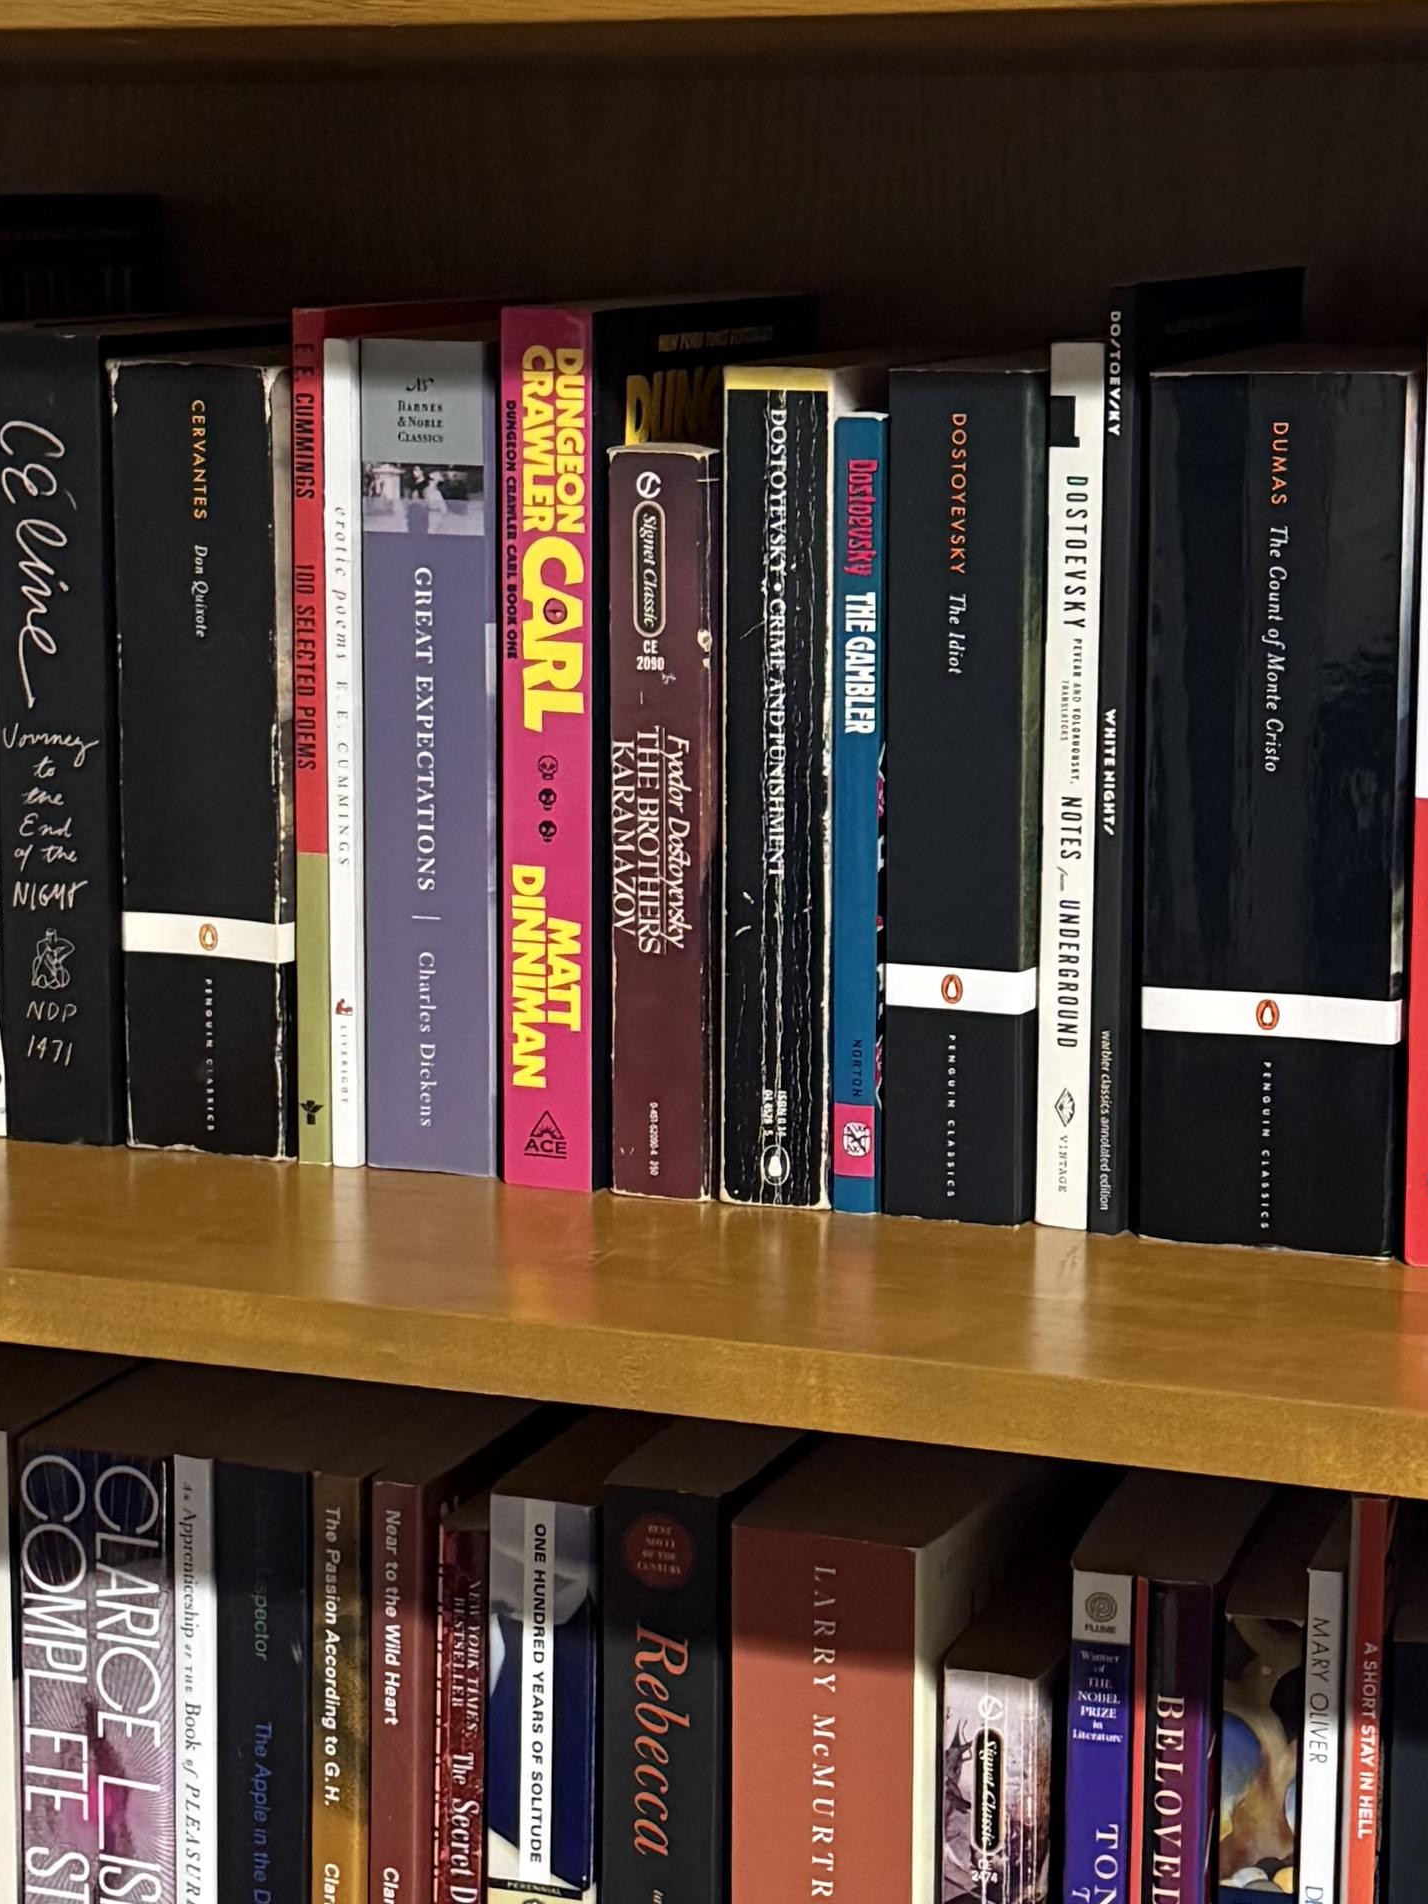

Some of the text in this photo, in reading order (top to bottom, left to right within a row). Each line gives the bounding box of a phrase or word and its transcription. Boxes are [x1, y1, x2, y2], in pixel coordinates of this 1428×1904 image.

[190, 399, 209, 639] CERVANTES Don Quixote
[522, 345, 555, 532] CRAWLER
[555, 347, 585, 534] DUNGEON
[1271, 421, 1289, 505] DUMAS
[522, 536, 585, 733] CARL
[947, 413, 968, 674] DOSTOYEVSKY The Idiot
[844, 592, 876, 735] THE GAMBLER
[414, 566, 436, 1128] GREAT EXPECTATIONS Charles Dickens
[1060, 796, 1082, 861] NOTES
[511, 864, 546, 1089] DINNIMAN
[547, 916, 581, 1032] MATT
[1056, 899, 1081, 1049] UNDERGROUND
[524, 1138, 567, 1156] ACE
[20, 1454, 90, 1822] COMPLETE
[93, 1464, 161, 1748] CLARICE
[633, 1620, 691, 1857] Rebecca
